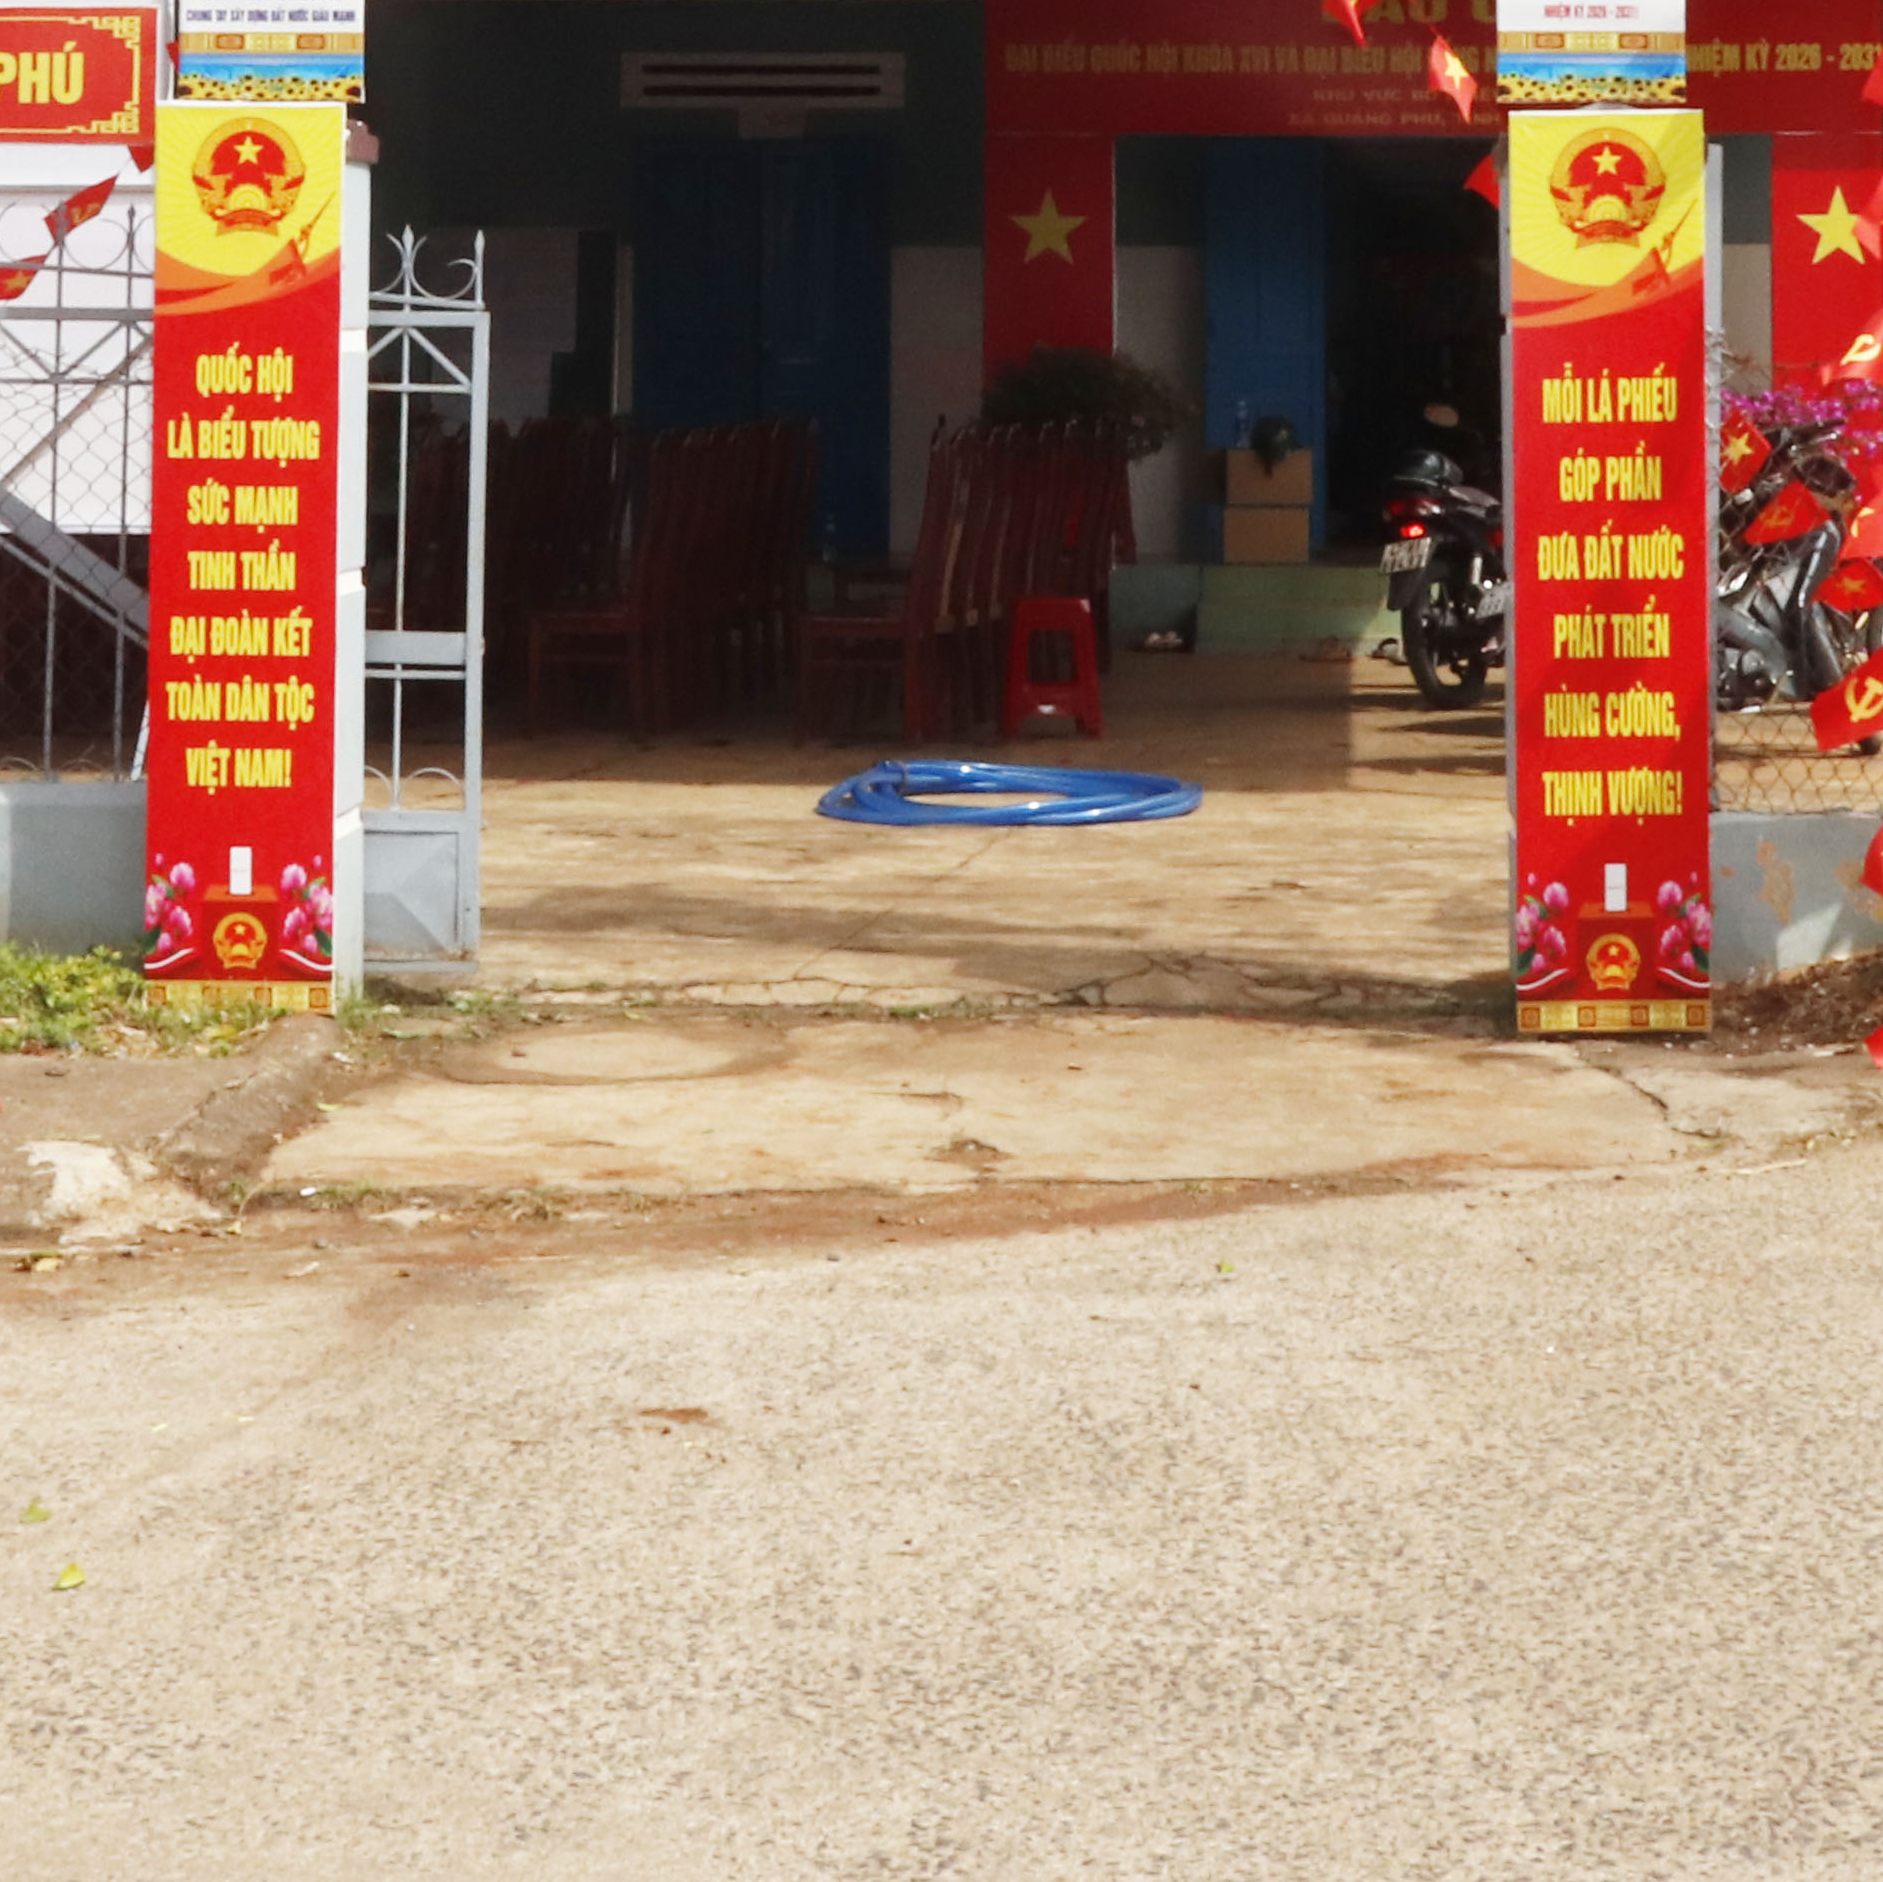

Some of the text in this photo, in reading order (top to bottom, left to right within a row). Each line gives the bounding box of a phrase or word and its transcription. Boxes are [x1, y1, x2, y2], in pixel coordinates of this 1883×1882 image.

[1745, 37, 1770, 71] KỲ
[1775, 42, 1822, 71] 2026
[196, 341, 293, 403] QUỐC HỘI
[1543, 362, 1678, 424] MỖI LÁ PHIẾU
[168, 405, 320, 468] LÀ BIỂU TƯỢNG
[1560, 440, 1662, 502] GÓP PHẦN
[187, 477, 298, 534] SỨC MẠNH
[188, 551, 236, 590] TINH
[1538, 519, 1684, 581] ĐƯA ĐẤT NƯỚC
[170, 605, 313, 663] ĐẠI ĐOÀN KẾT
[1554, 594, 1670, 659] PHÁT TRIỂN
[165, 674, 314, 730] TOÀN DÂN TỘC
[1544, 680, 1681, 741] HÙNG CƯỜNG,
[186, 739, 292, 795] VIỆT NAM!
[1542, 766, 1683, 827] THỊNH VƯỢNG!
